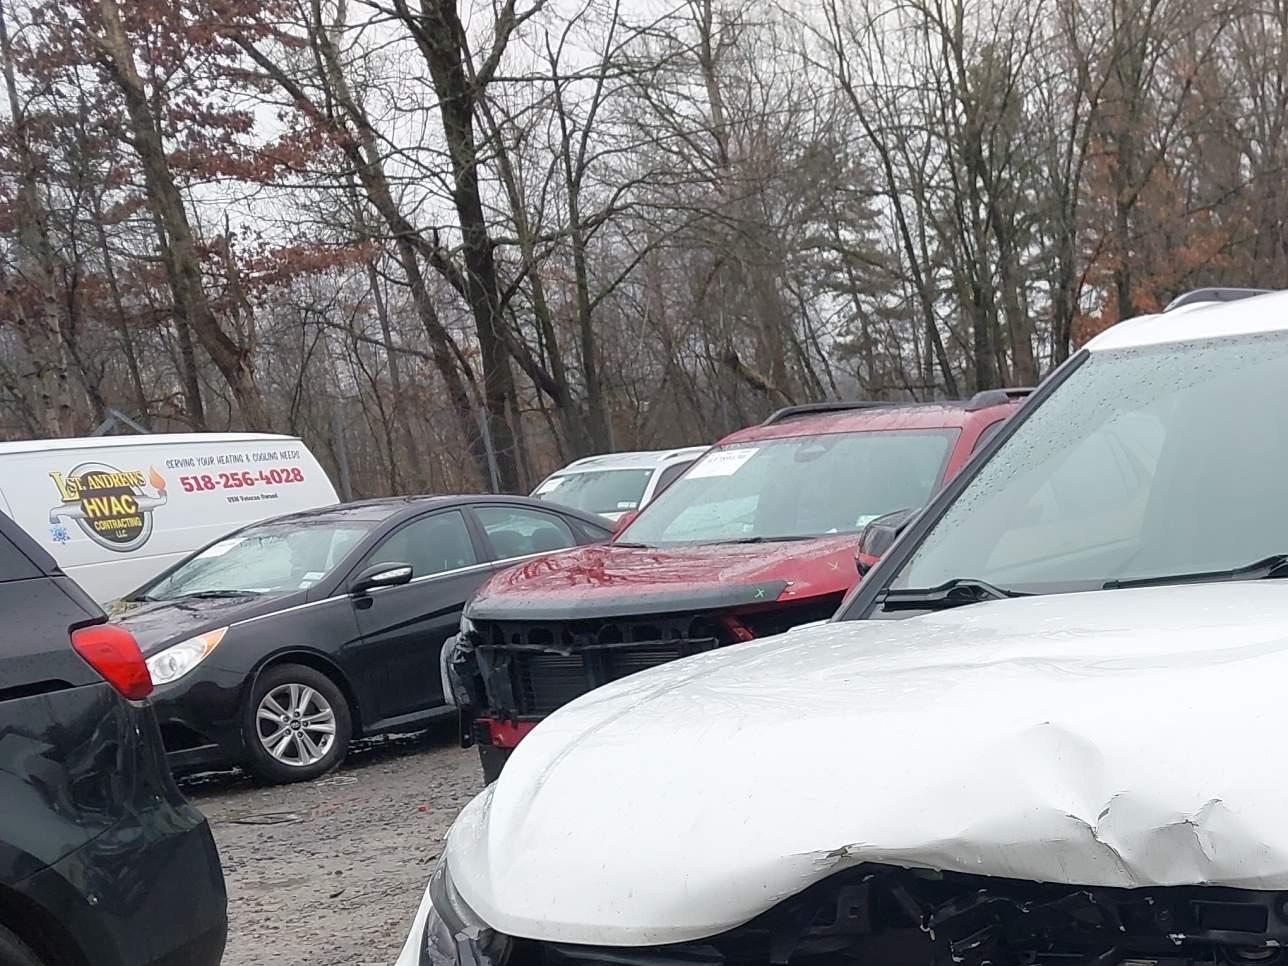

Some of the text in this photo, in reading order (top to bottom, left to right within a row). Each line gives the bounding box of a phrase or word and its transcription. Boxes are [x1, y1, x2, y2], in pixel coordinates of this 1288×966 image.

[166, 457, 195, 469] SERVING
[196, 456, 216, 467] YOUR
[217, 454, 244, 466] HEATING
[252, 452, 279, 462] COOLING
[280, 450, 301, 460] NEEDS
[88, 470, 147, 490] ANDREWS
[180, 467, 304, 493] 518-256-4028
[82, 494, 137, 518] HVAC
[94, 517, 142, 532] CONTRACTING
[115, 530, 128, 539] LLC
